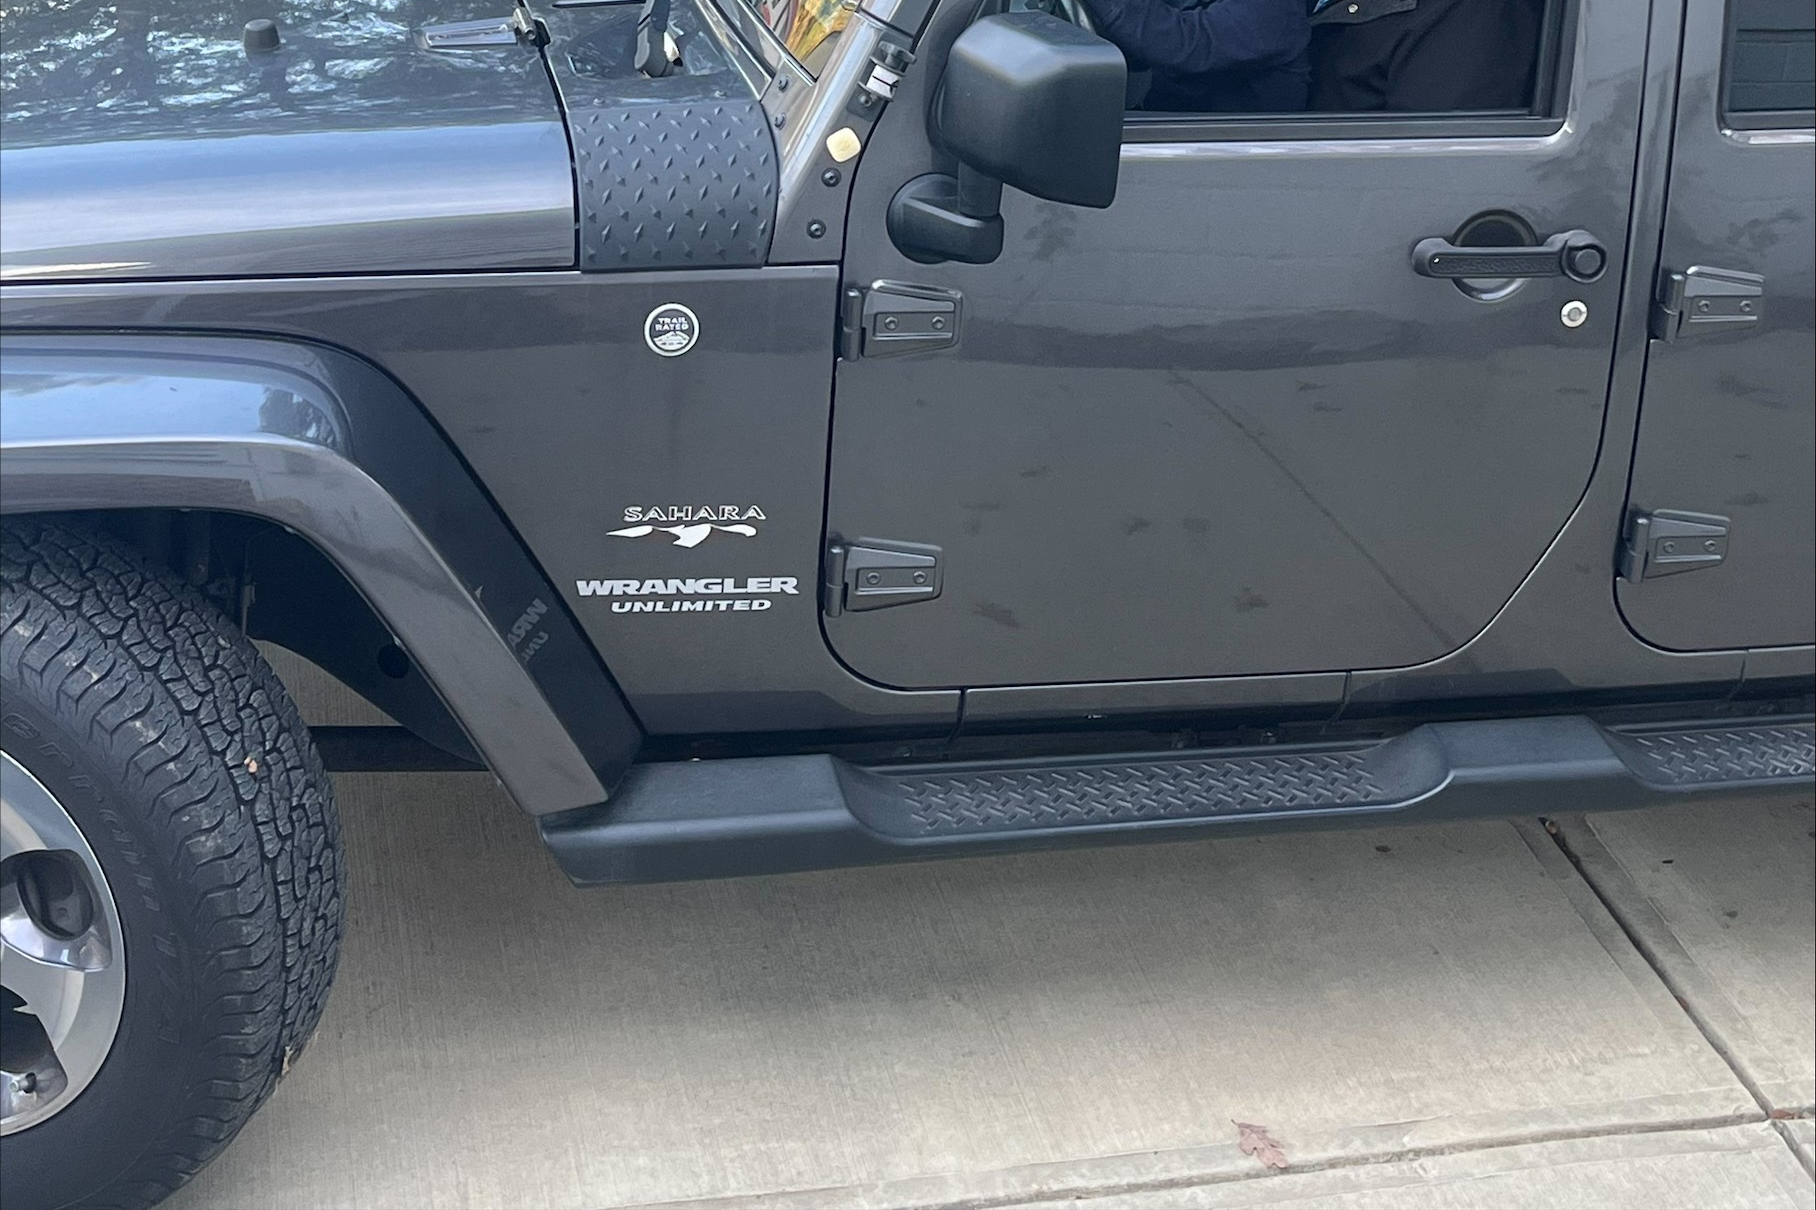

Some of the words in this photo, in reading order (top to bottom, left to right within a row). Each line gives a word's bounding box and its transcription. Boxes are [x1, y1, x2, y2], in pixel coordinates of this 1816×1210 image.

[655, 323, 689, 331] RATED
[658, 316, 687, 324] TRAIL
[623, 505, 767, 521] SAHARA
[576, 576, 799, 596] WRANGLER
[611, 599, 772, 613] UNLIMITED
